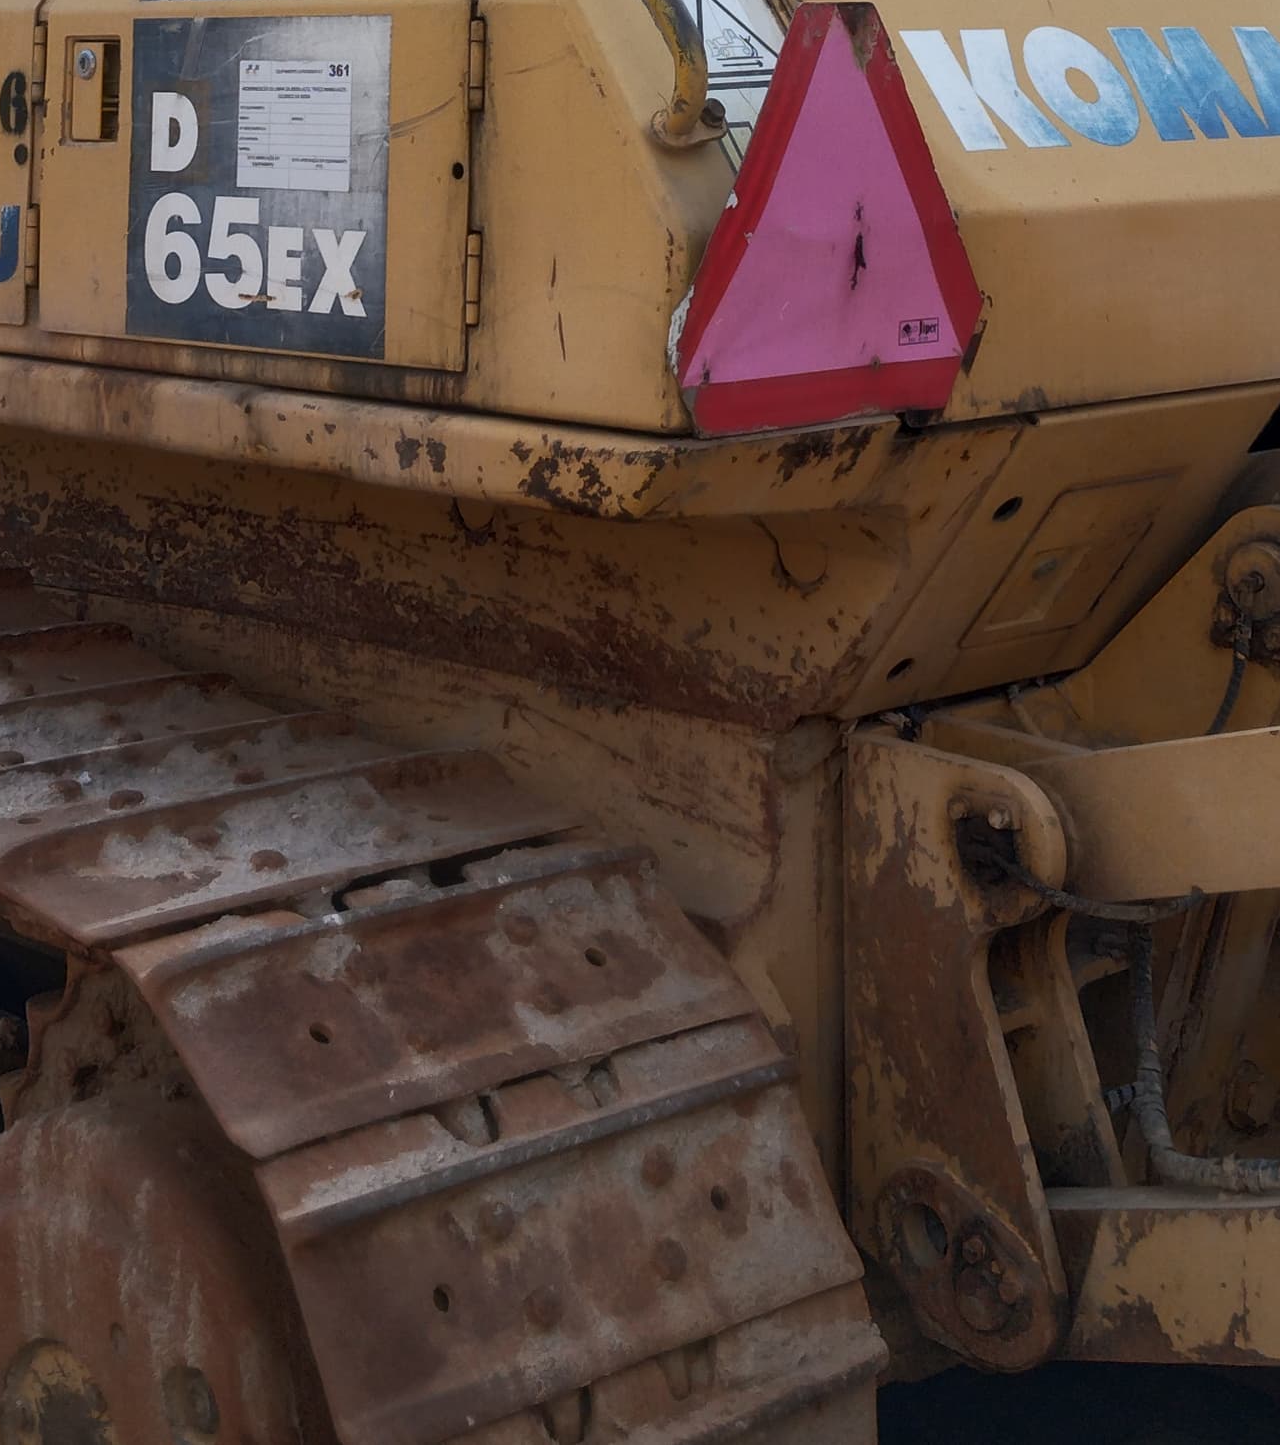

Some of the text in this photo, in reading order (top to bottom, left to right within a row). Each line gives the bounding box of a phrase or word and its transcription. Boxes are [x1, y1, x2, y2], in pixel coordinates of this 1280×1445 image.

[328, 64, 350, 77] 361
[150, 92, 199, 172] D
[144, 191, 368, 318] 65EX
